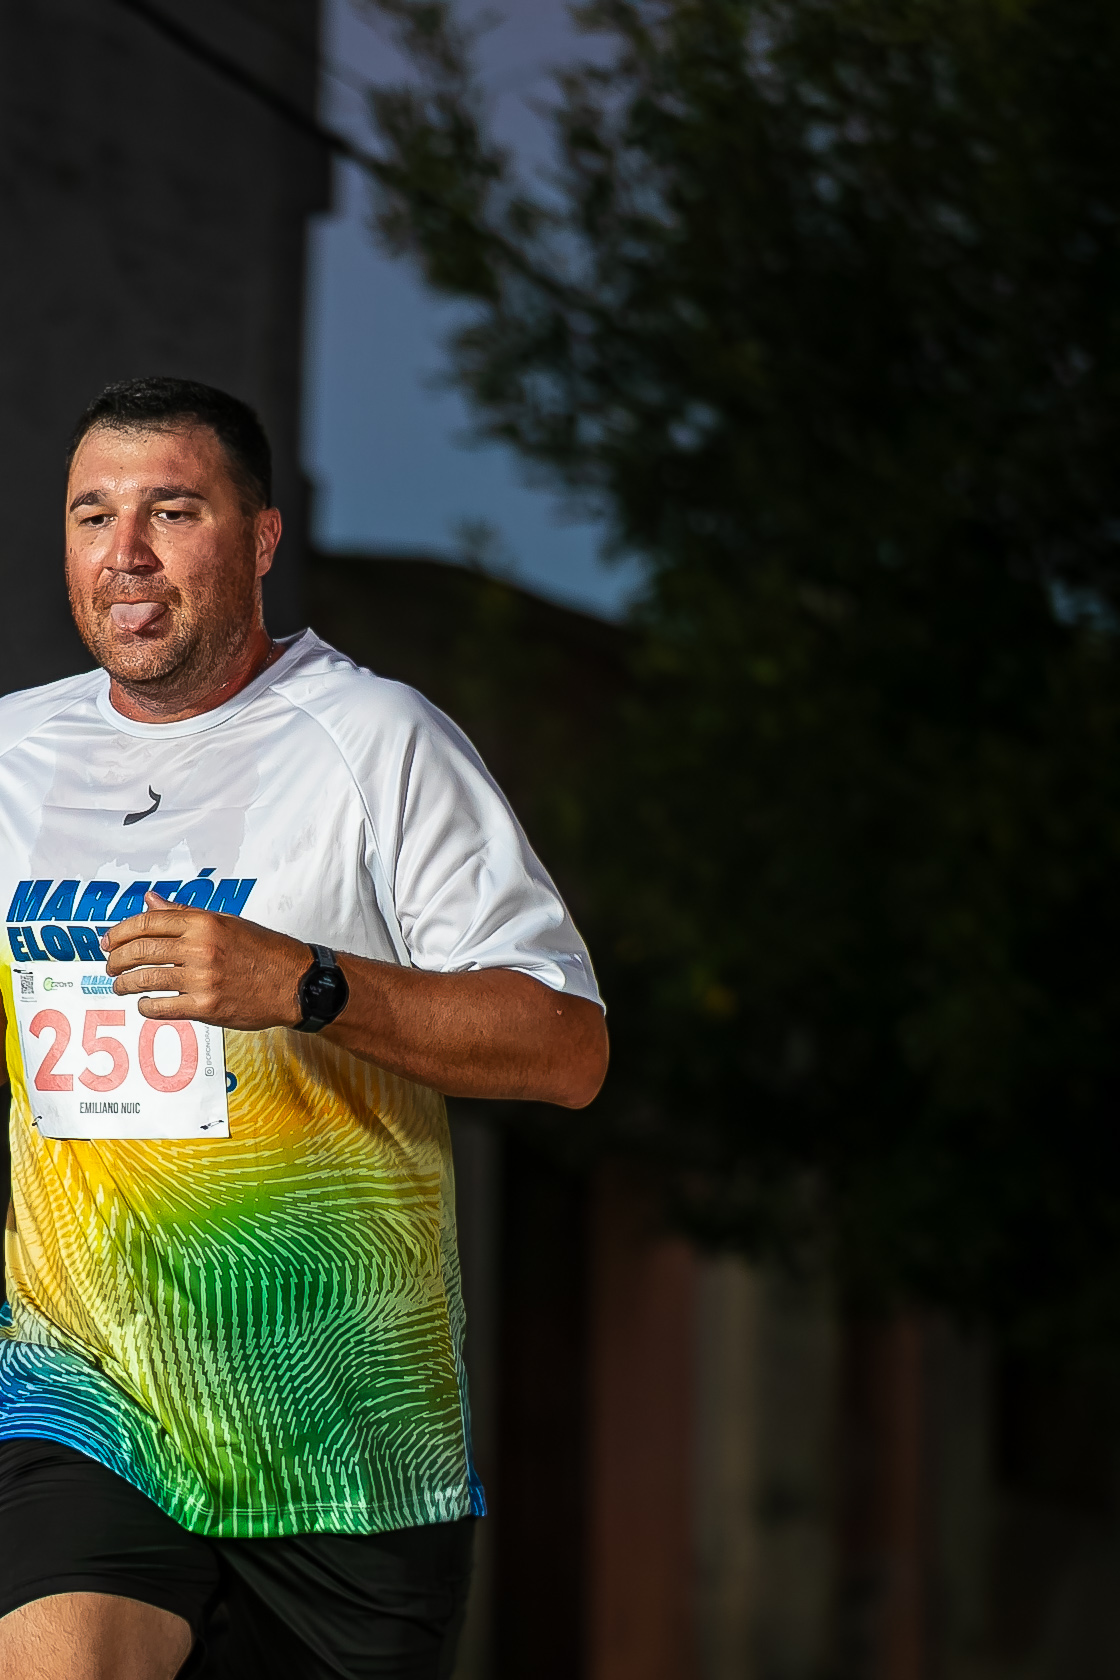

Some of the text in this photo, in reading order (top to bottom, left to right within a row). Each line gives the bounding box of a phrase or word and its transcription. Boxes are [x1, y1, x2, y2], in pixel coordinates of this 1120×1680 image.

[7, 925, 111, 962] ELOR
[29, 1008, 199, 1093] 250
[80, 1102, 141, 1114] EMILIANO NUIC
